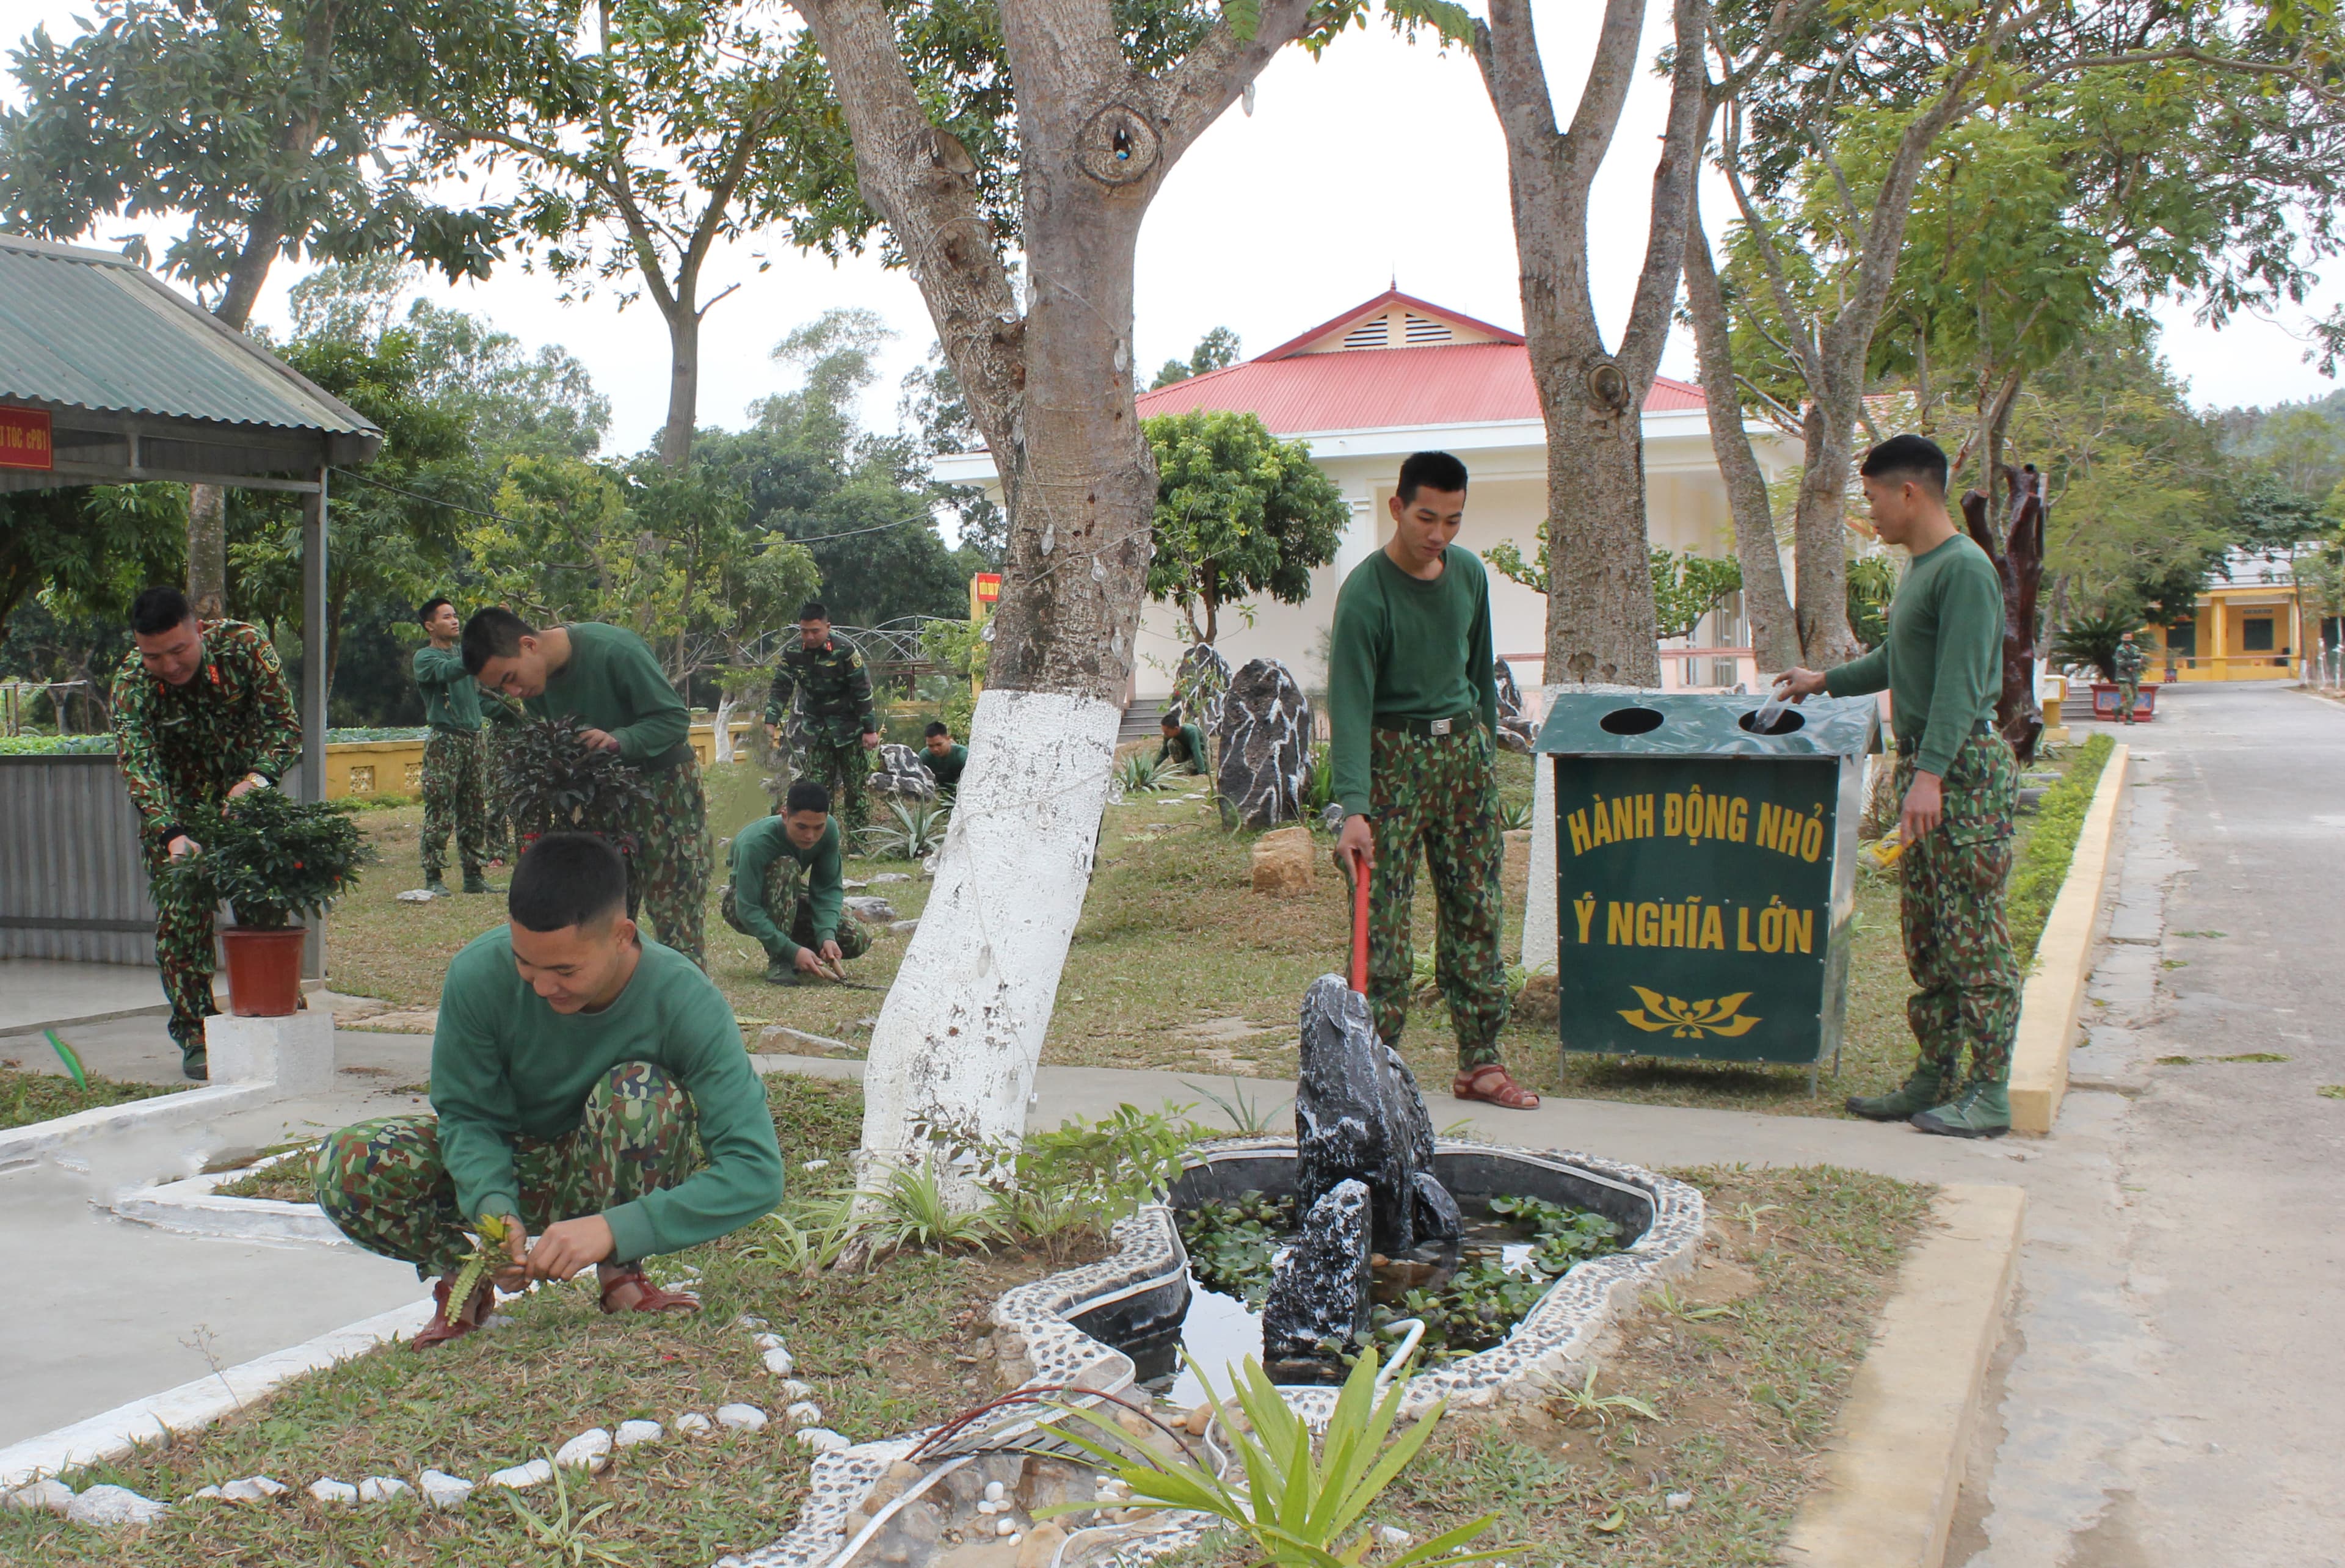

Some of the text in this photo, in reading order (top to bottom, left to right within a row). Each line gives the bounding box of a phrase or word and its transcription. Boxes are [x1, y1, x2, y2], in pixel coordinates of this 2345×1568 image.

[1568, 784, 1824, 863] HÀNH ĐỘNG NHỎ
[1574, 891, 1813, 954] Ý NGHĨA LỚN
